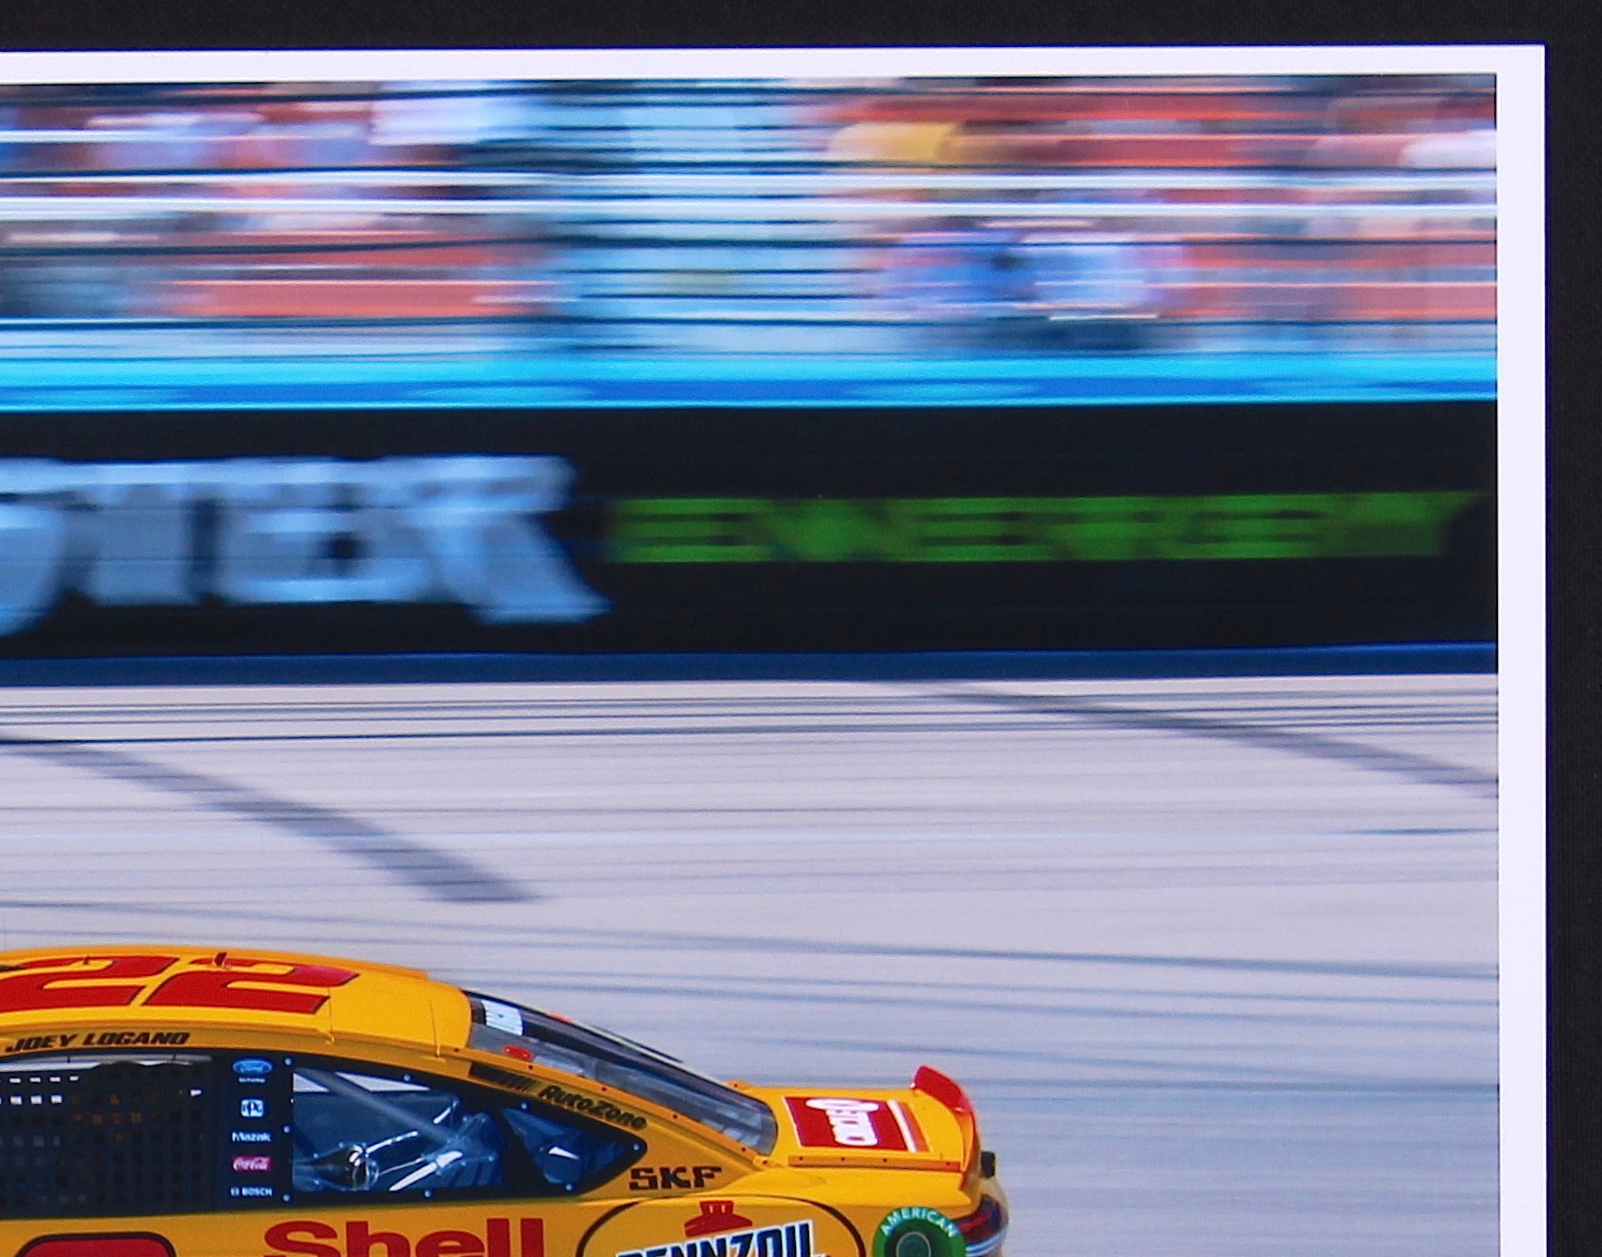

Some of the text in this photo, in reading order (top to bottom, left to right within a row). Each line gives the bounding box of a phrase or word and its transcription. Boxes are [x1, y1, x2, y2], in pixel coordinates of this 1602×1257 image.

[5, 1032, 190, 1052] JOEY LOGANO
[539, 1085, 646, 1131] AutoZone
[232, 1132, 271, 1142] Mazak
[629, 1166, 722, 1190] SKF
[242, 1187, 272, 1196] BOSCH
[880, 1207, 958, 1238] AMERICAN
